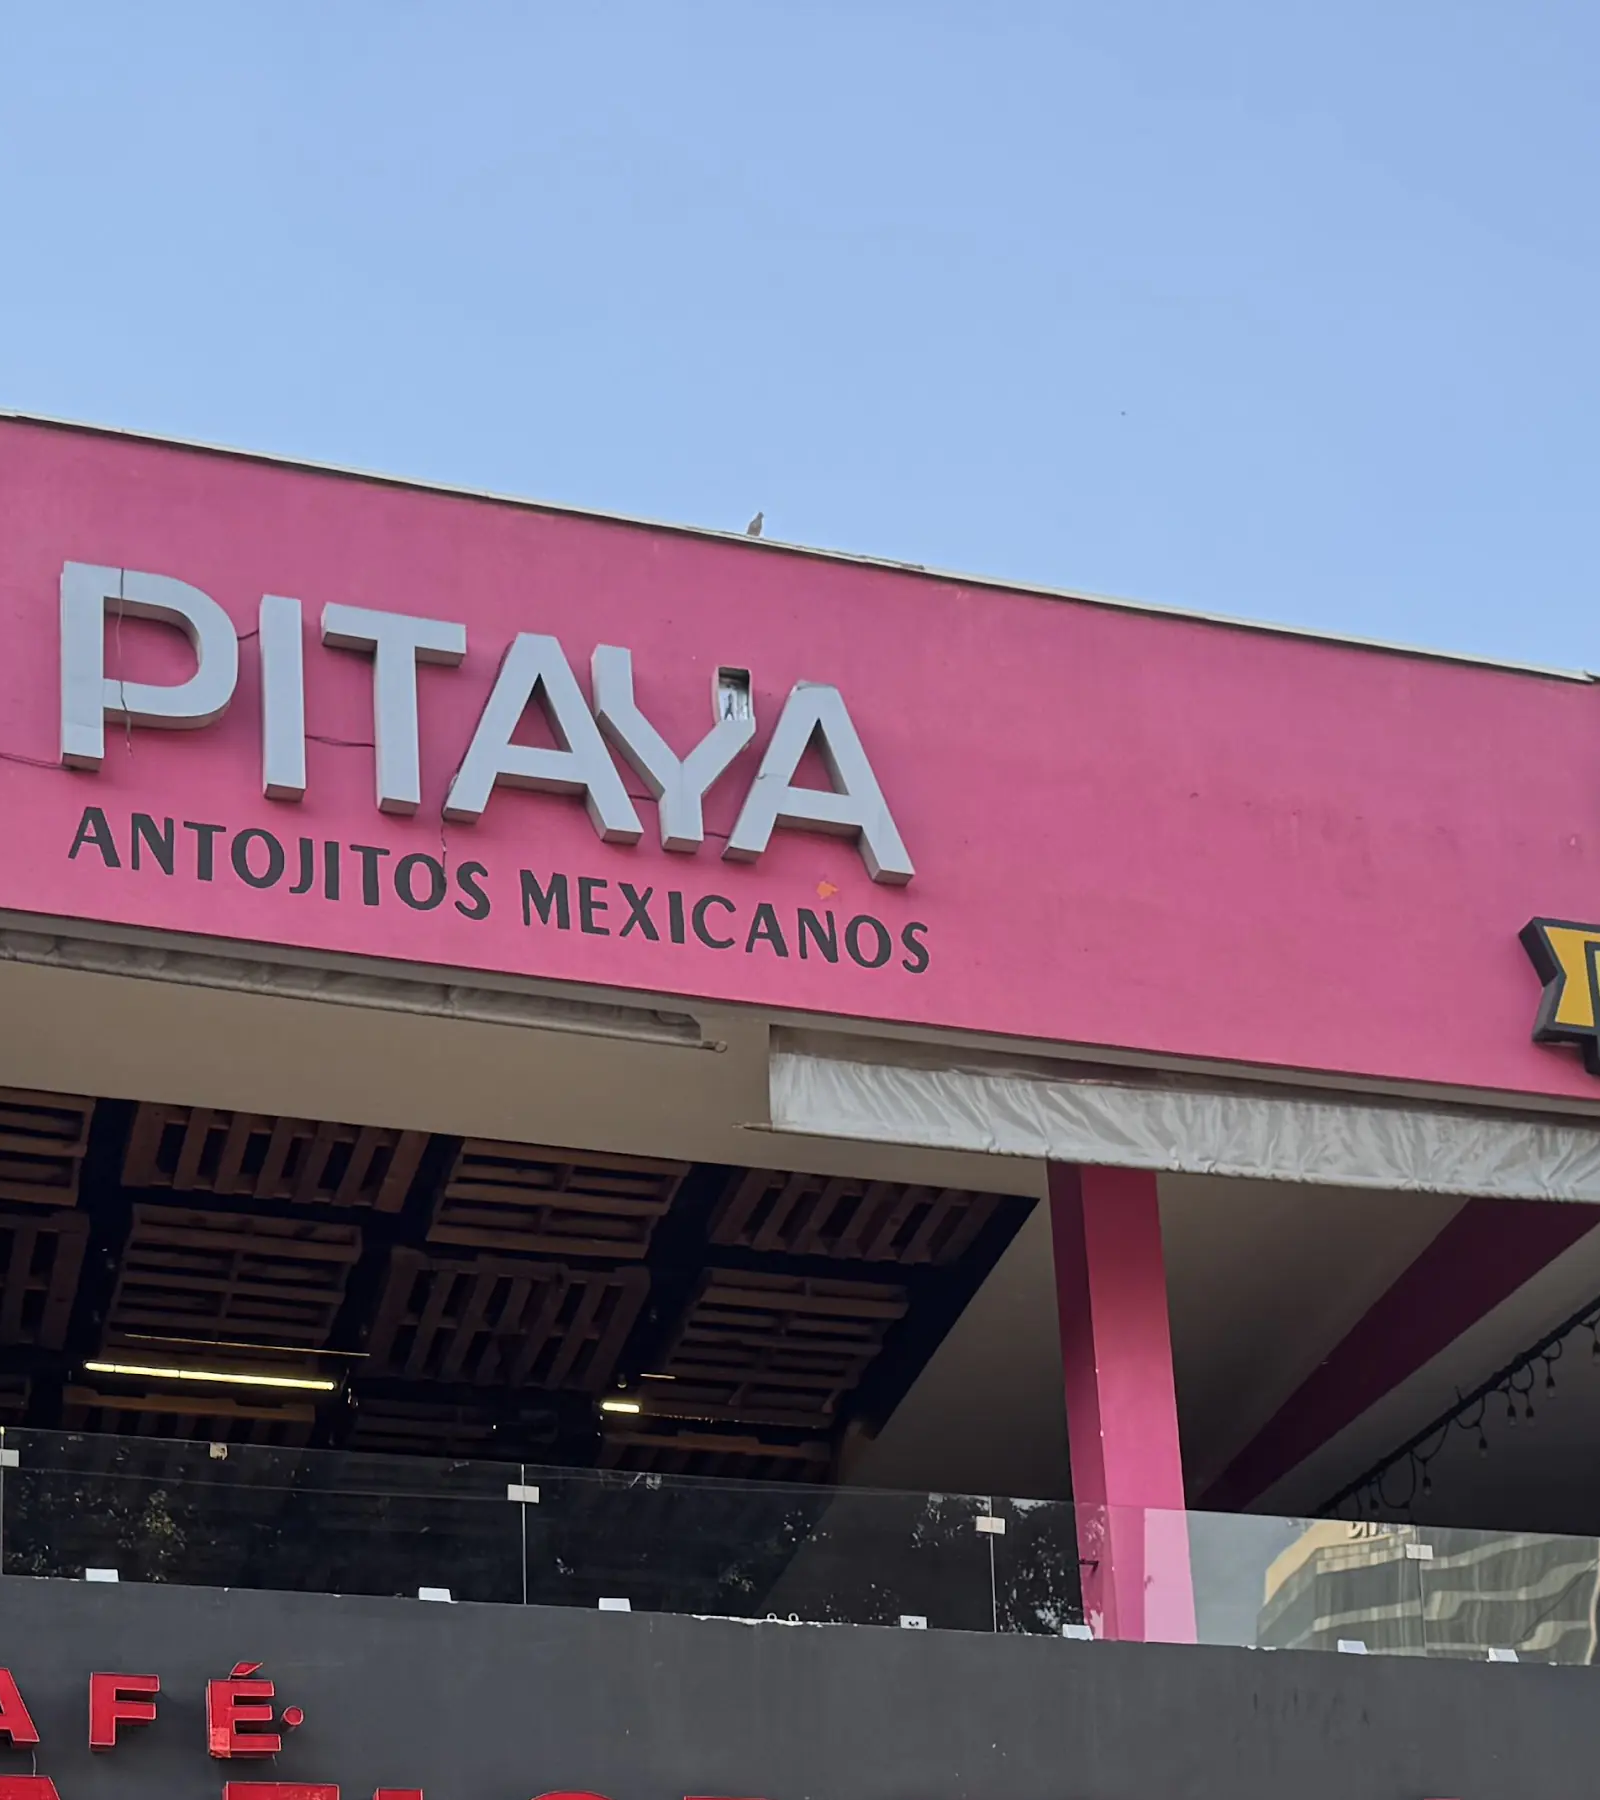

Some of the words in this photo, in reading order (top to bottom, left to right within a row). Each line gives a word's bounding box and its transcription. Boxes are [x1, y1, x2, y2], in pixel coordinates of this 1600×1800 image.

[59, 560, 915, 887] PITAYA
[67, 806, 492, 921] ANTOJITOS
[520, 869, 932, 974] MEXICANOS
